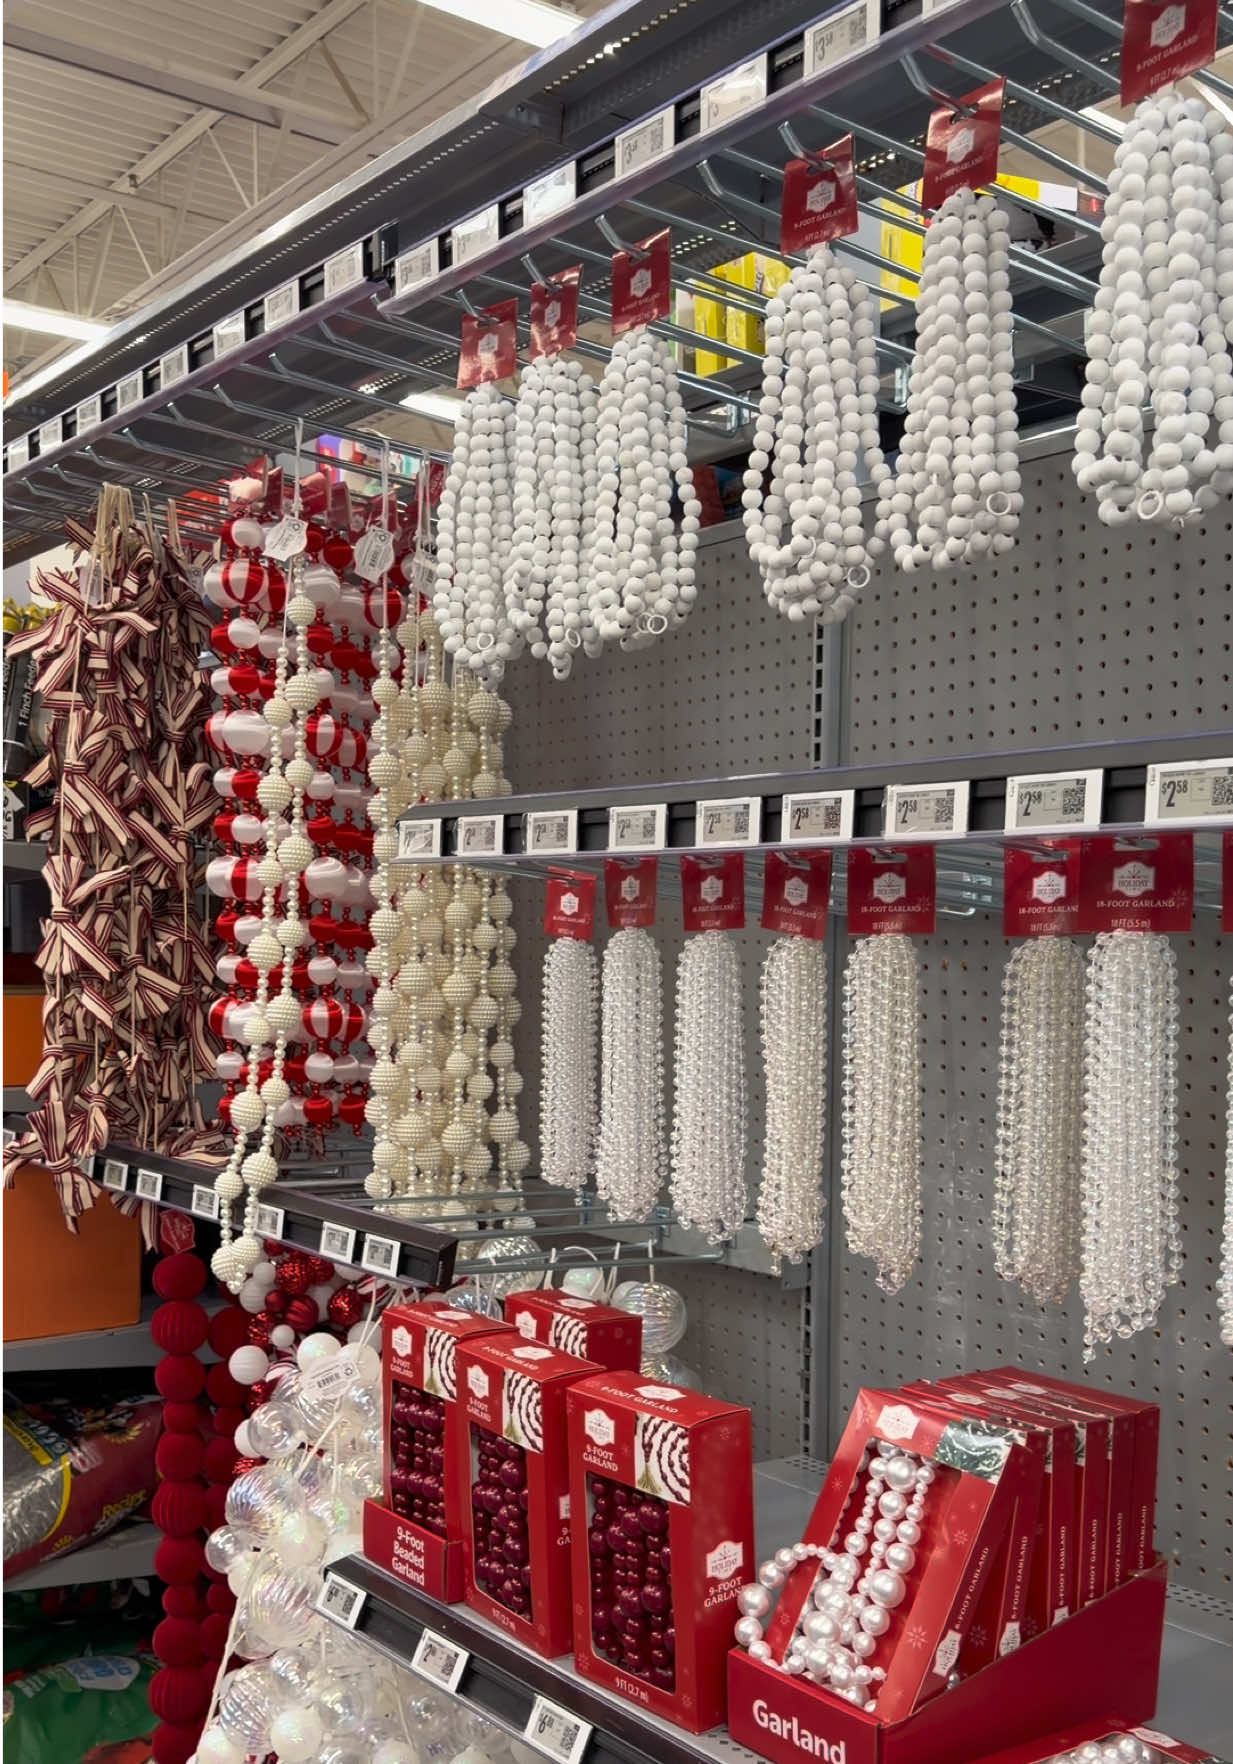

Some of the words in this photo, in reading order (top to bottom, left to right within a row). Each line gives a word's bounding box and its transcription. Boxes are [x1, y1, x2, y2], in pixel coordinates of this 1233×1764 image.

[20, 690, 34, 718] Finch
[1118, 879, 1149, 887] HOLIDAY
[888, 904, 921, 913] GARLAND
[1096, 900, 1130, 908] 18-FOOT
[1132, 899, 1176, 908] GARLAND
[633, 1396, 680, 1414] GARLAND
[583, 1451, 619, 1472] GARLAND
[396, 1525, 425, 1554] 9-Foot
[1090, 1519, 1098, 1562] GARLAND
[393, 1539, 425, 1570] Beaded
[1017, 1535, 1029, 1582] GARLAND
[391, 1556, 425, 1587] Garland
[968, 1547, 990, 1592] GARLAND
[708, 1576, 743, 1596] 9-FOOT
[752, 1699, 847, 1764] Garland
